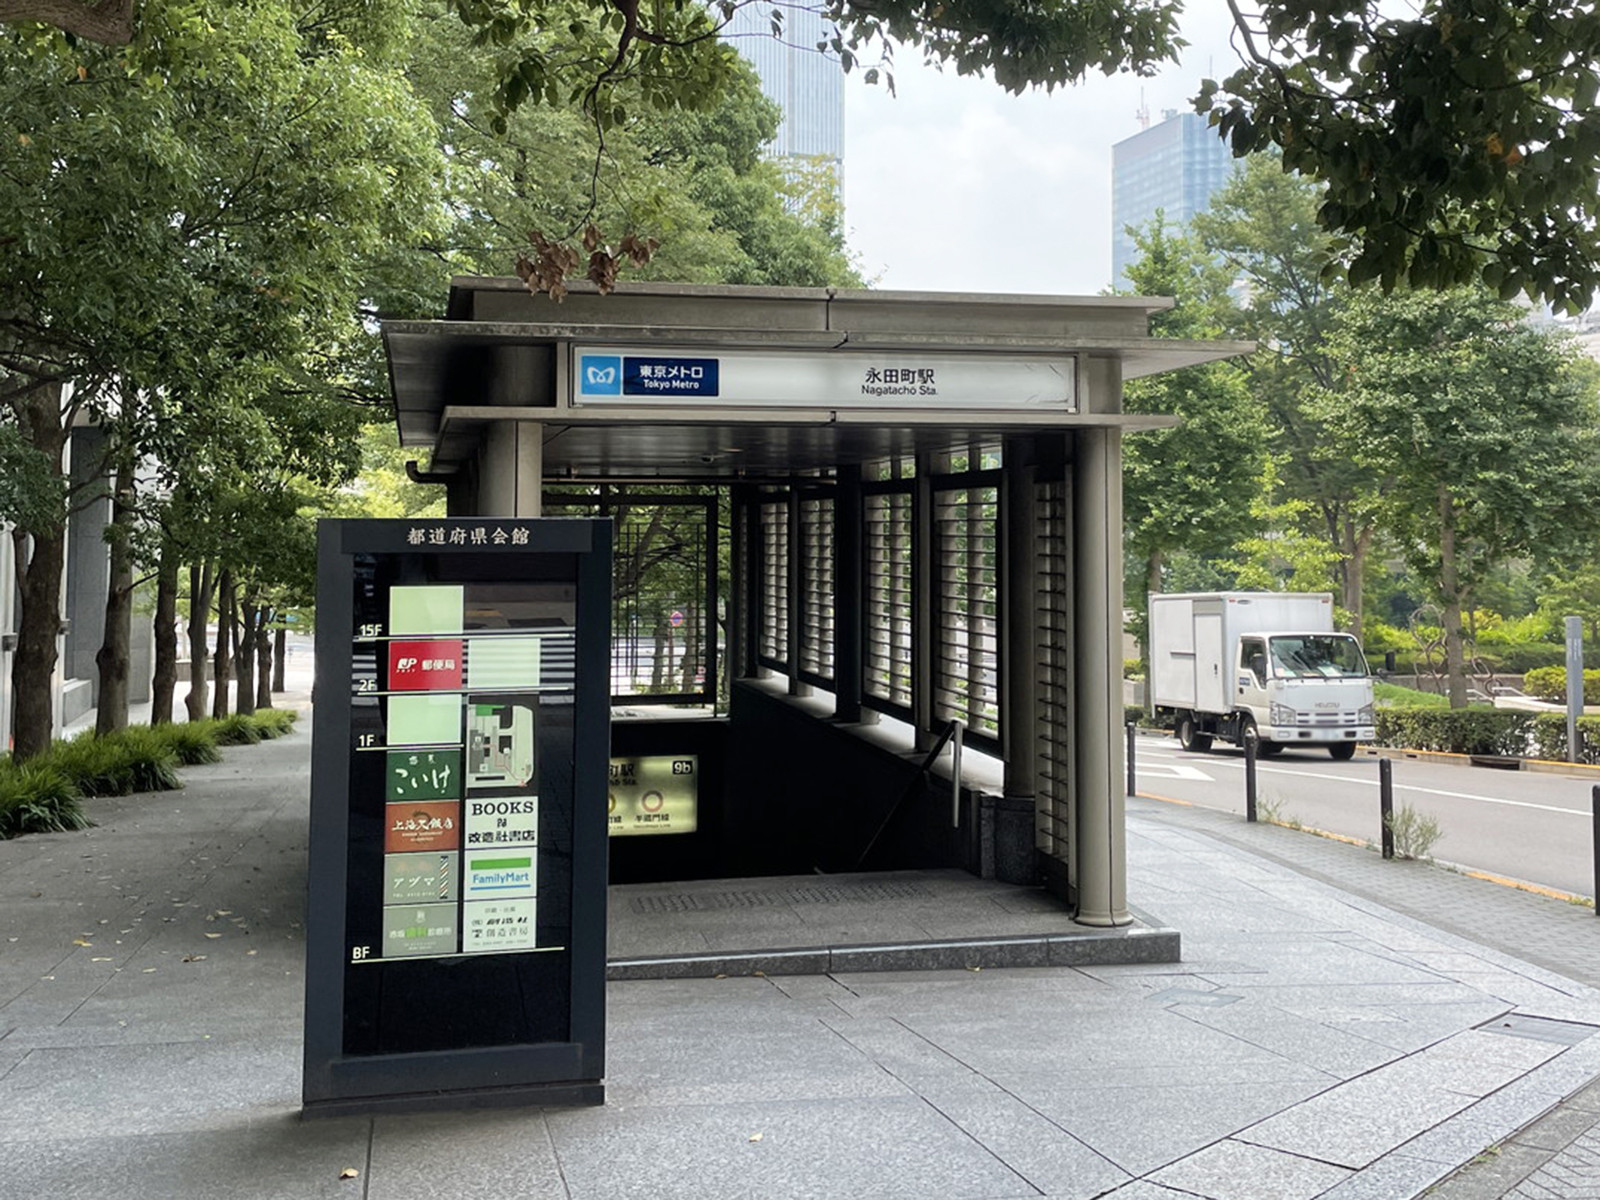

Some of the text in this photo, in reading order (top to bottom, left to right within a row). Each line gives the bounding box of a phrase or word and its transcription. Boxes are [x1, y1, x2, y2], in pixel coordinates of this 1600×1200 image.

[639, 365, 703, 379] 東京メトロ
[865, 367, 935, 384] 永田町駅
[643, 379, 700, 390] Tokyo Metro
[918, 385, 938, 395] Sta.
[407, 527, 531, 545] 都道府県会館
[359, 624, 382, 636] 15F
[422, 659, 456, 671] 郵便局
[358, 679, 376, 691] 2F
[358, 734, 375, 747] 1F
[674, 762, 692, 774] 9b
[472, 801, 534, 816] BOOKS
[473, 872, 529, 885] FamilyMart
[352, 946, 370, 959] BF
